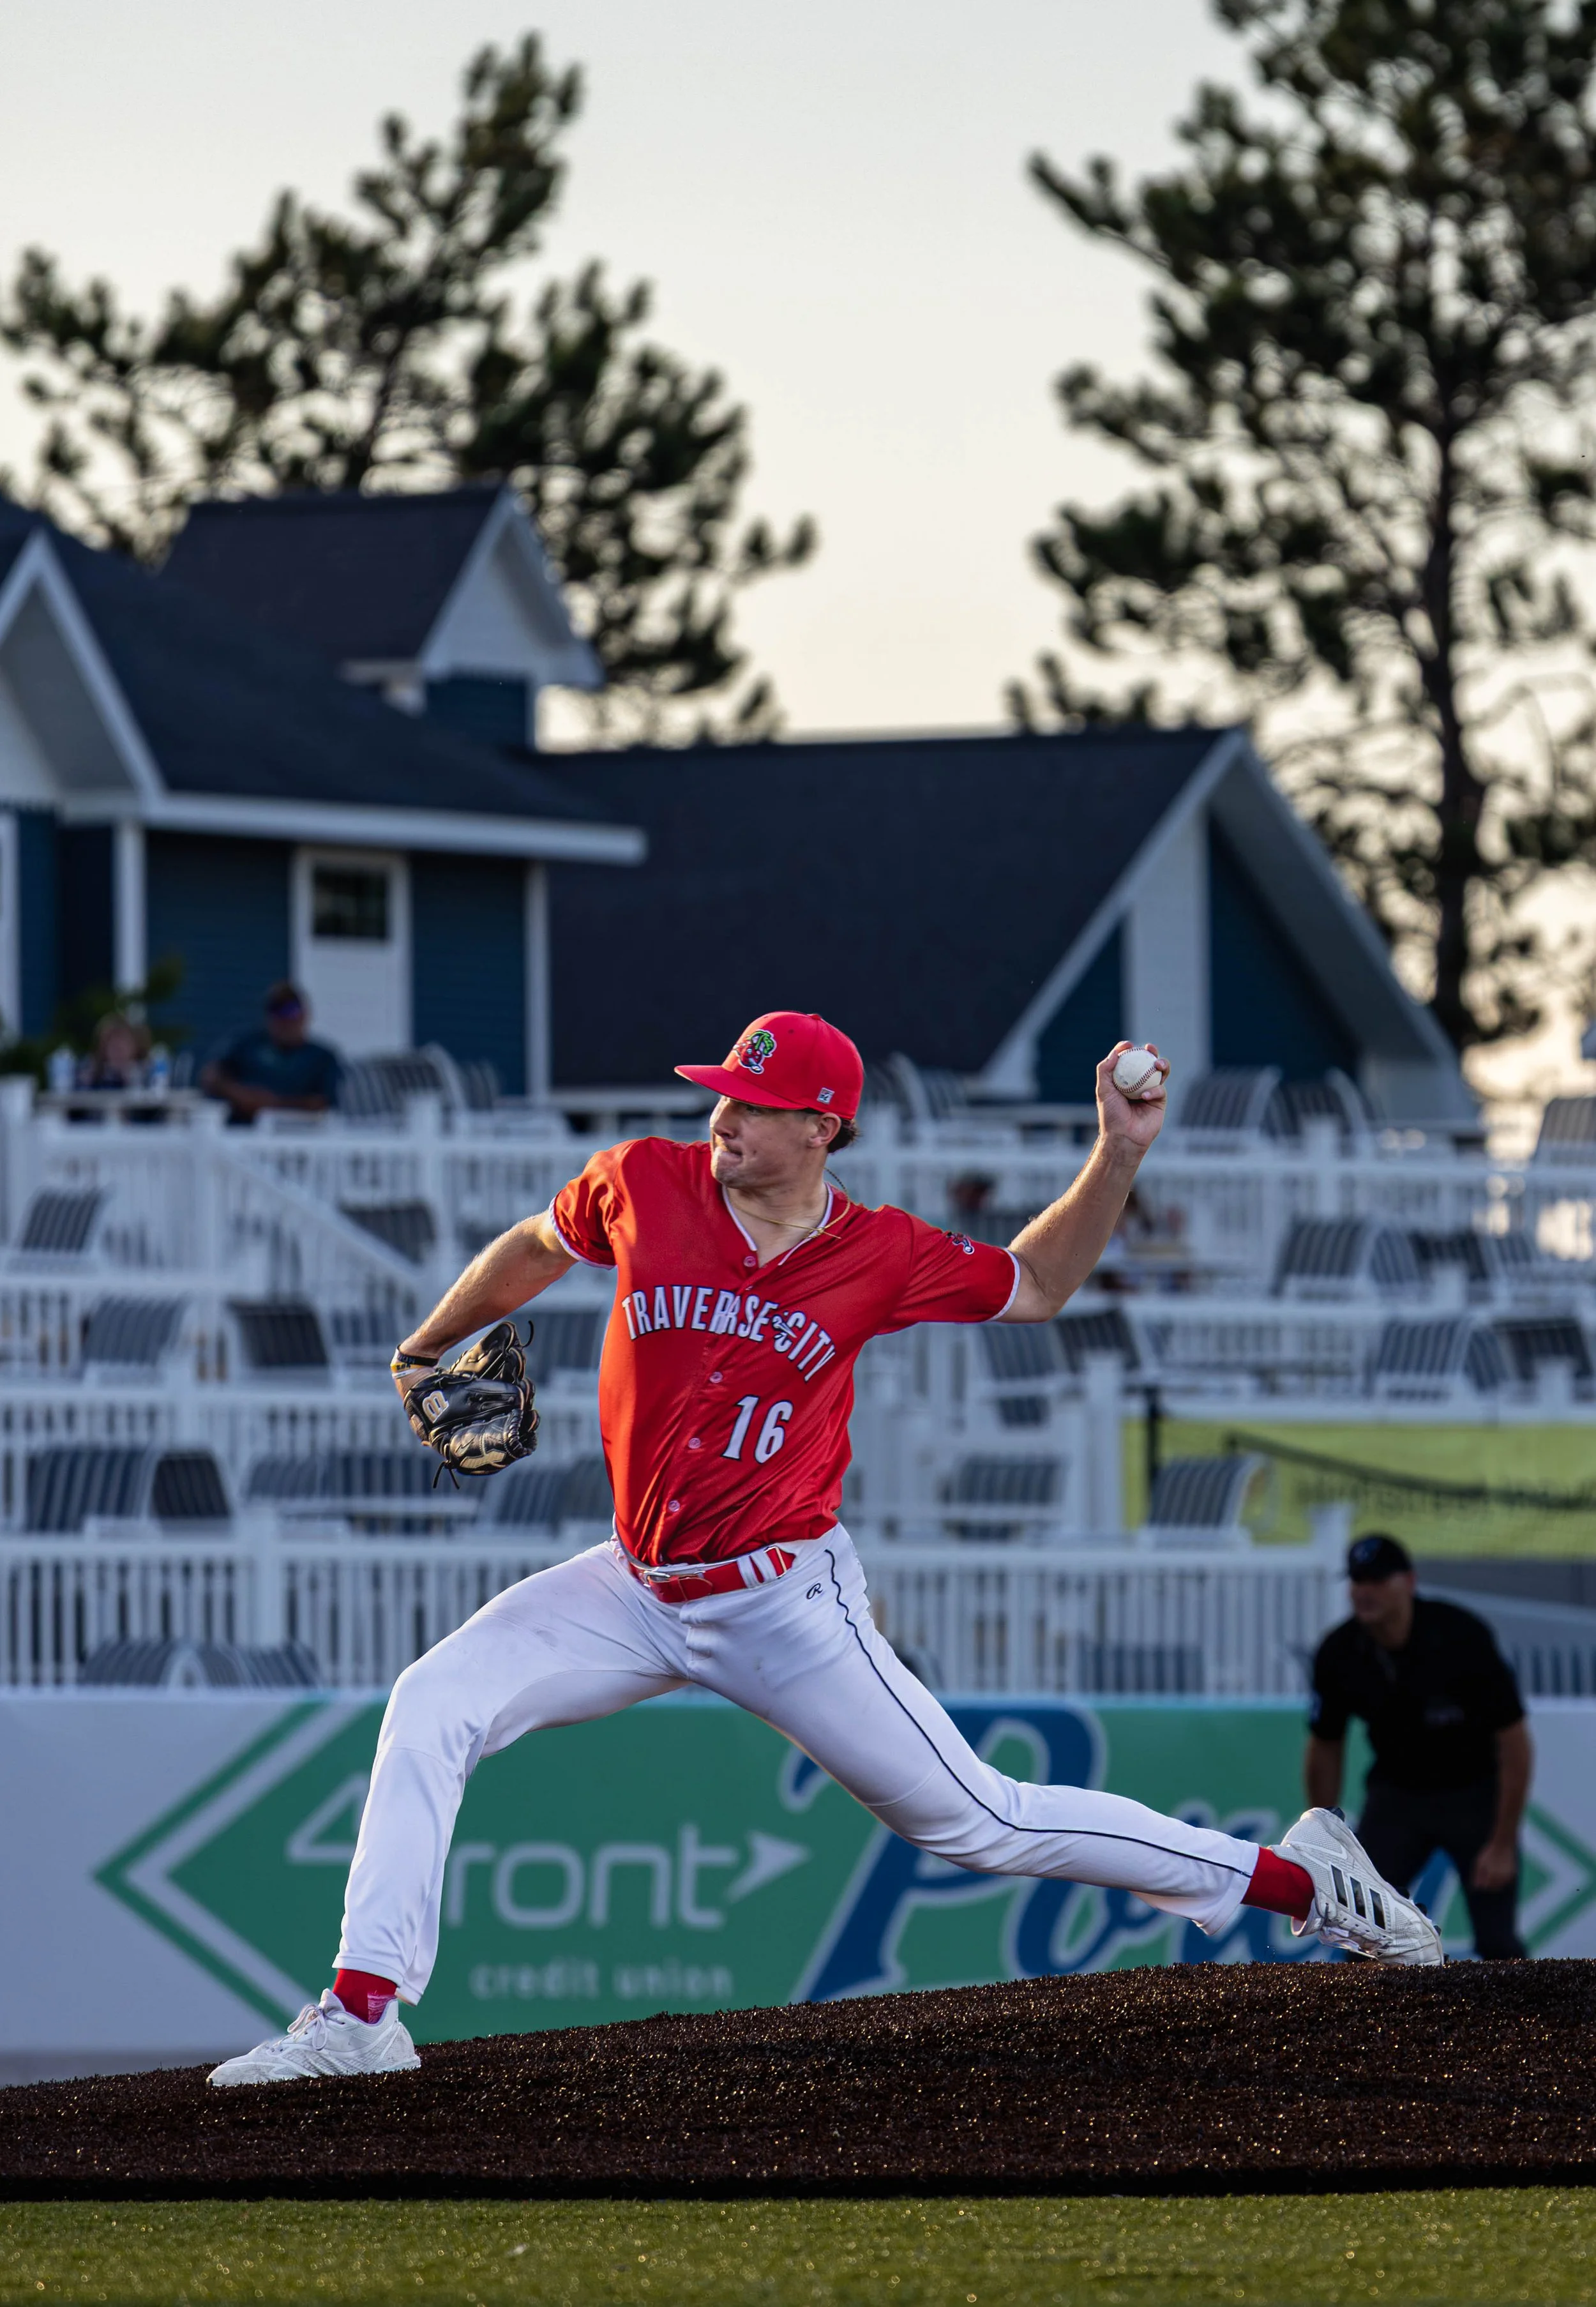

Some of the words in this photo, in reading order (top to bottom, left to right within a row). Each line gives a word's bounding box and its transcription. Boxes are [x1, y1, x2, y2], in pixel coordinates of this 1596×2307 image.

[622, 1285, 779, 1342] TRAVERSE
[773, 1311, 836, 1382] CITY
[720, 1395, 795, 1464] 16
[287, 1772, 737, 1930] 4ront
[470, 1958, 600, 2000] credit
[614, 1959, 732, 2000] union
